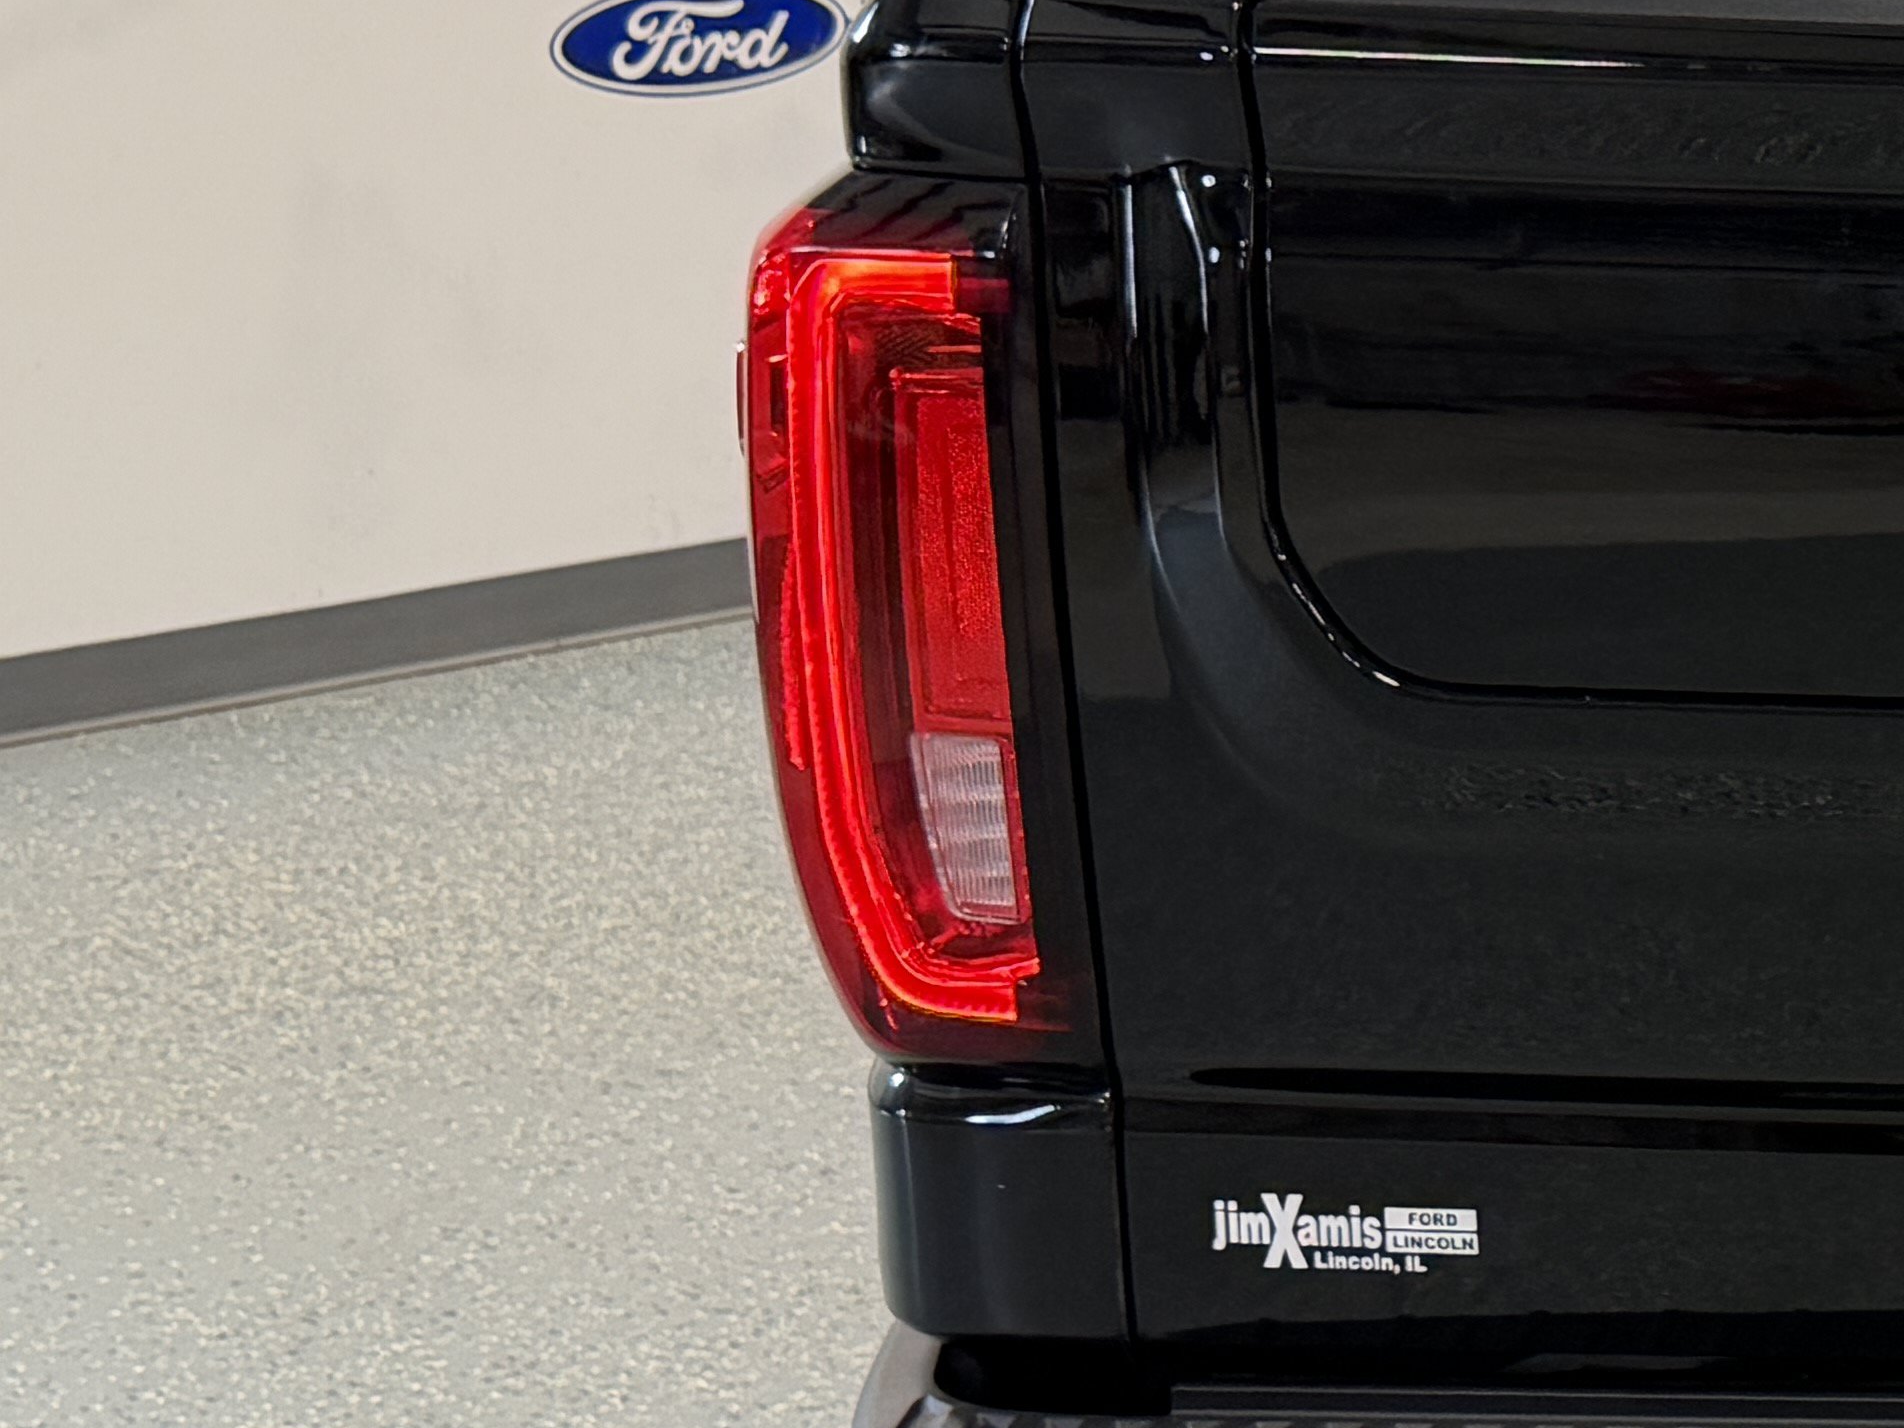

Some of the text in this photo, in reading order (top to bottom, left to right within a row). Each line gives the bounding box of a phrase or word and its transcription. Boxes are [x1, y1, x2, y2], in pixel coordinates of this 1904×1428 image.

[1407, 1211, 1459, 1228] FORD
[1391, 1234, 1475, 1252] LINCOLN
[1313, 1250, 1429, 1275] Lincoln, IL
